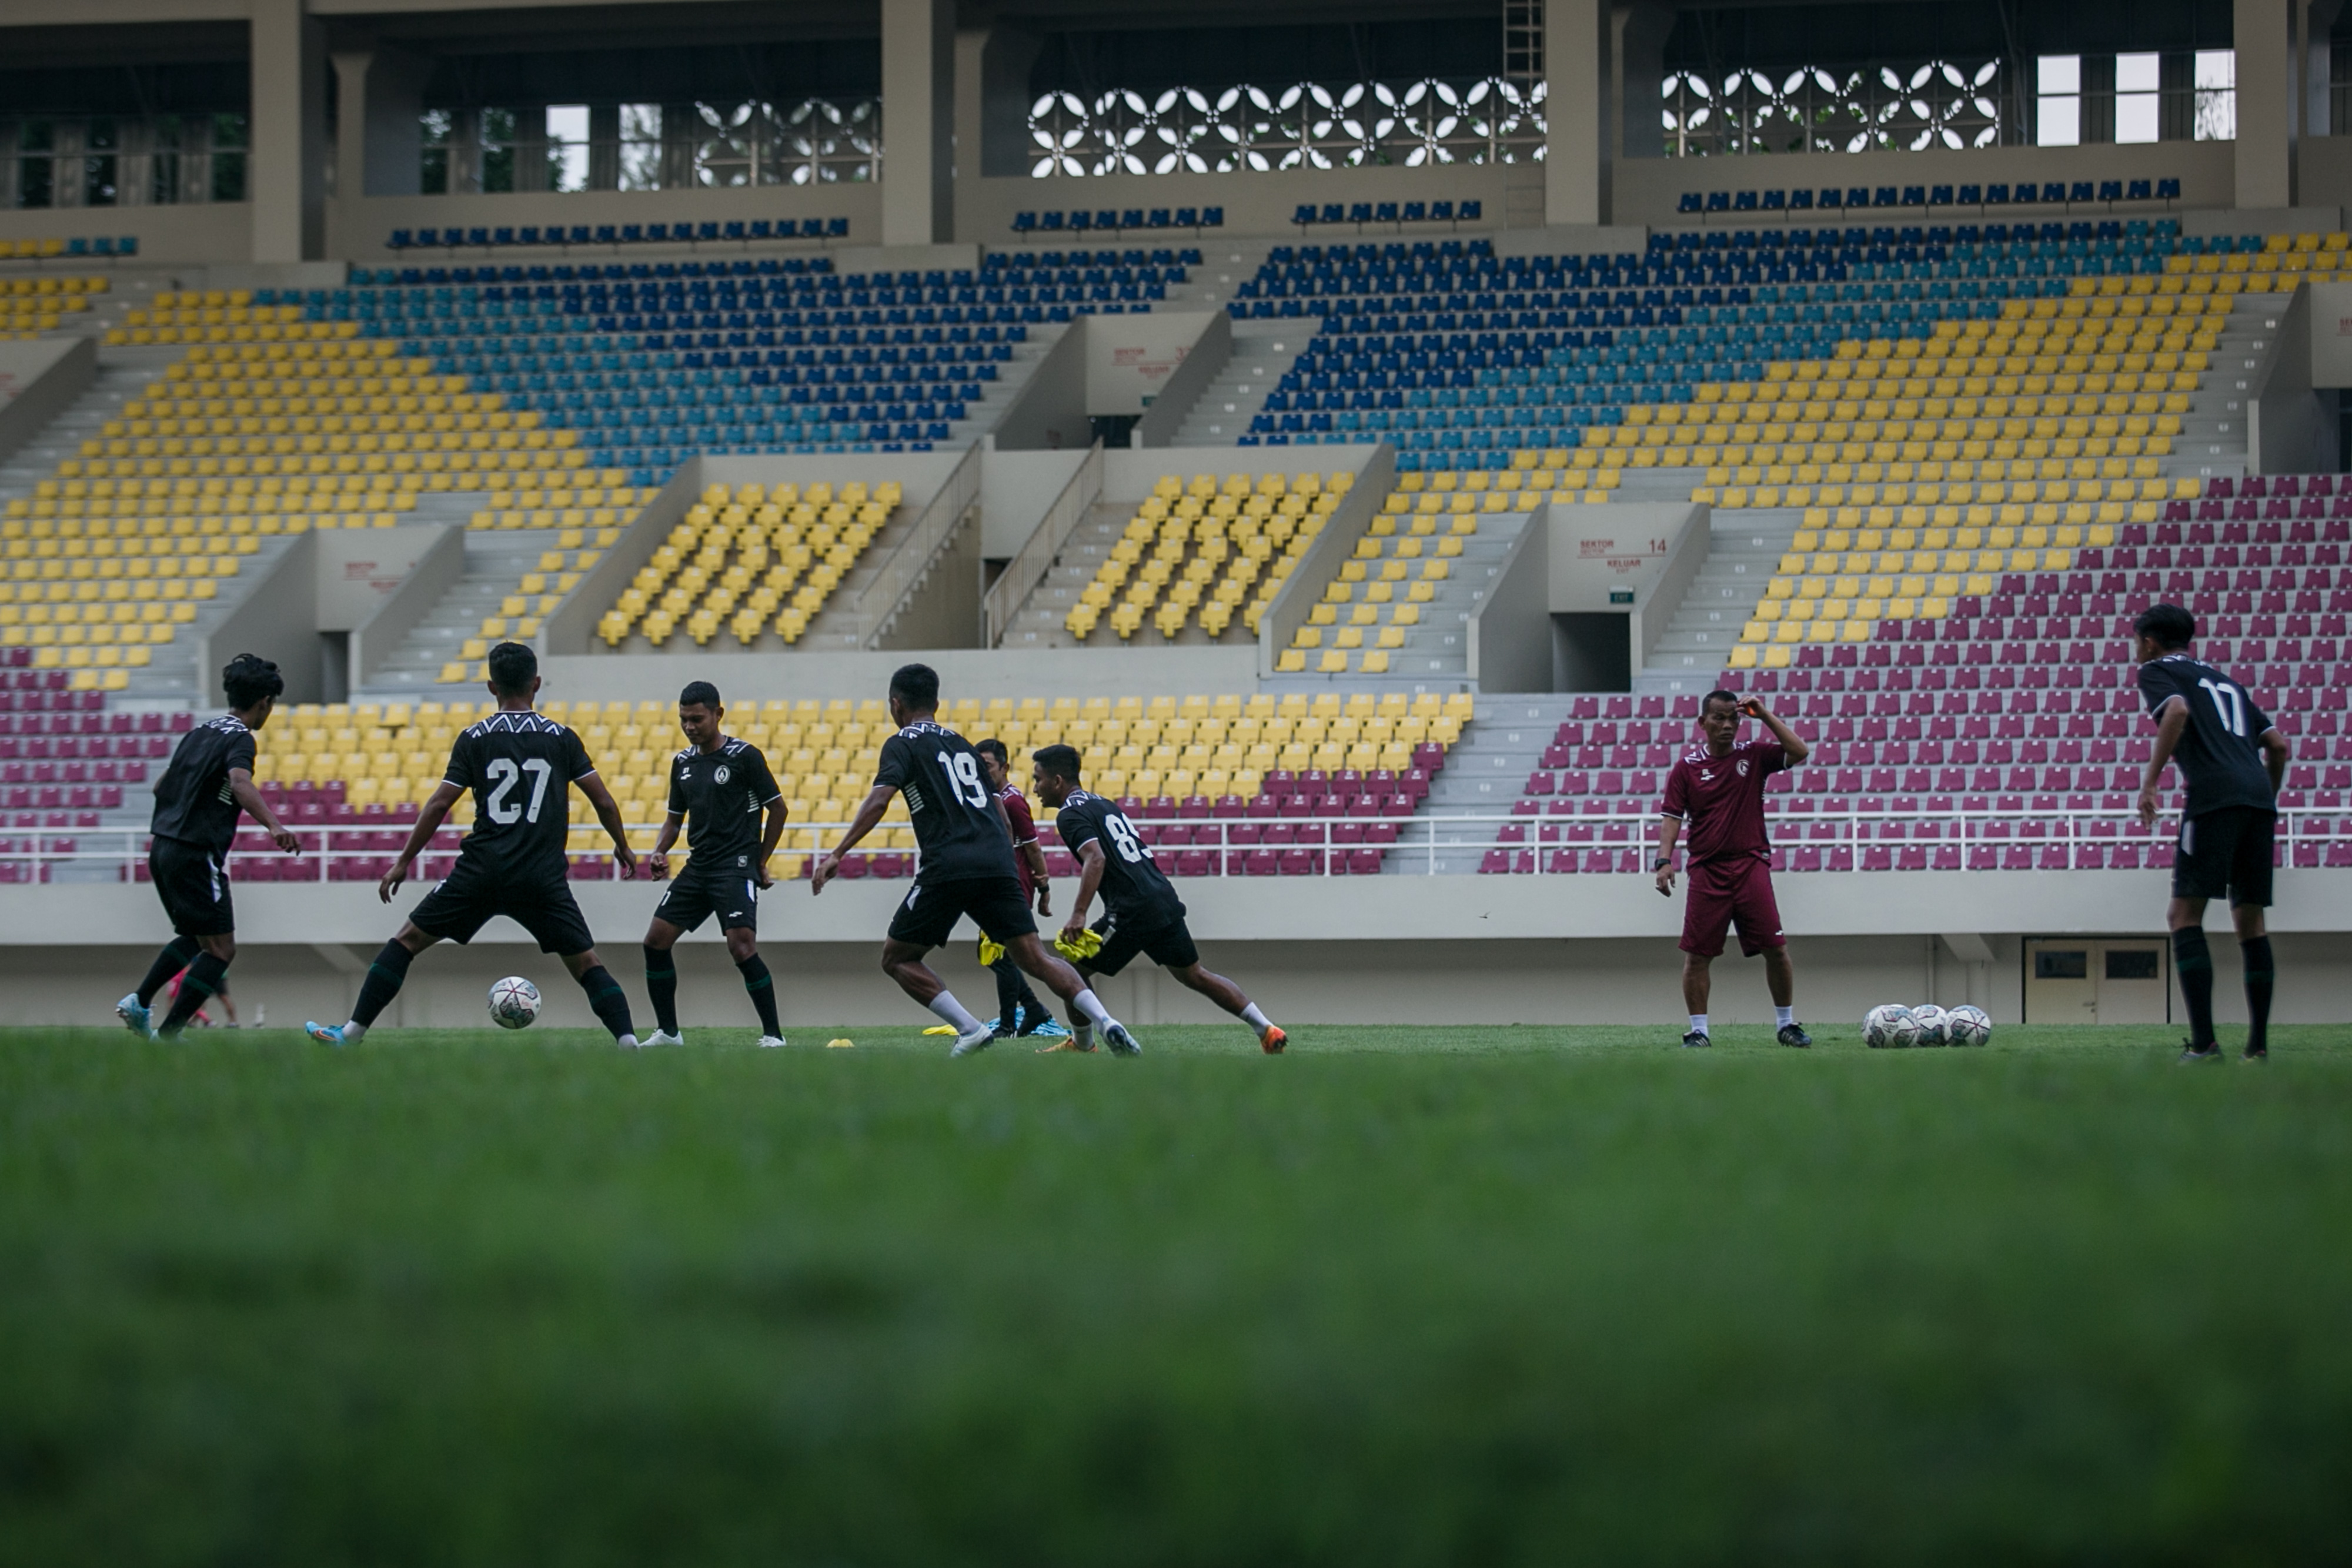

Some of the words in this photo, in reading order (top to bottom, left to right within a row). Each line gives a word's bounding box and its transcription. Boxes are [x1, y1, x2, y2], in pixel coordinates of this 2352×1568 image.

[1580, 539, 1614, 549] SEKTOR
[1649, 538, 1666, 554] 14
[1607, 559, 1641, 568] KELUAR
[2198, 677, 2246, 737] 17
[487, 758, 552, 824] 27
[937, 751, 987, 808] 19
